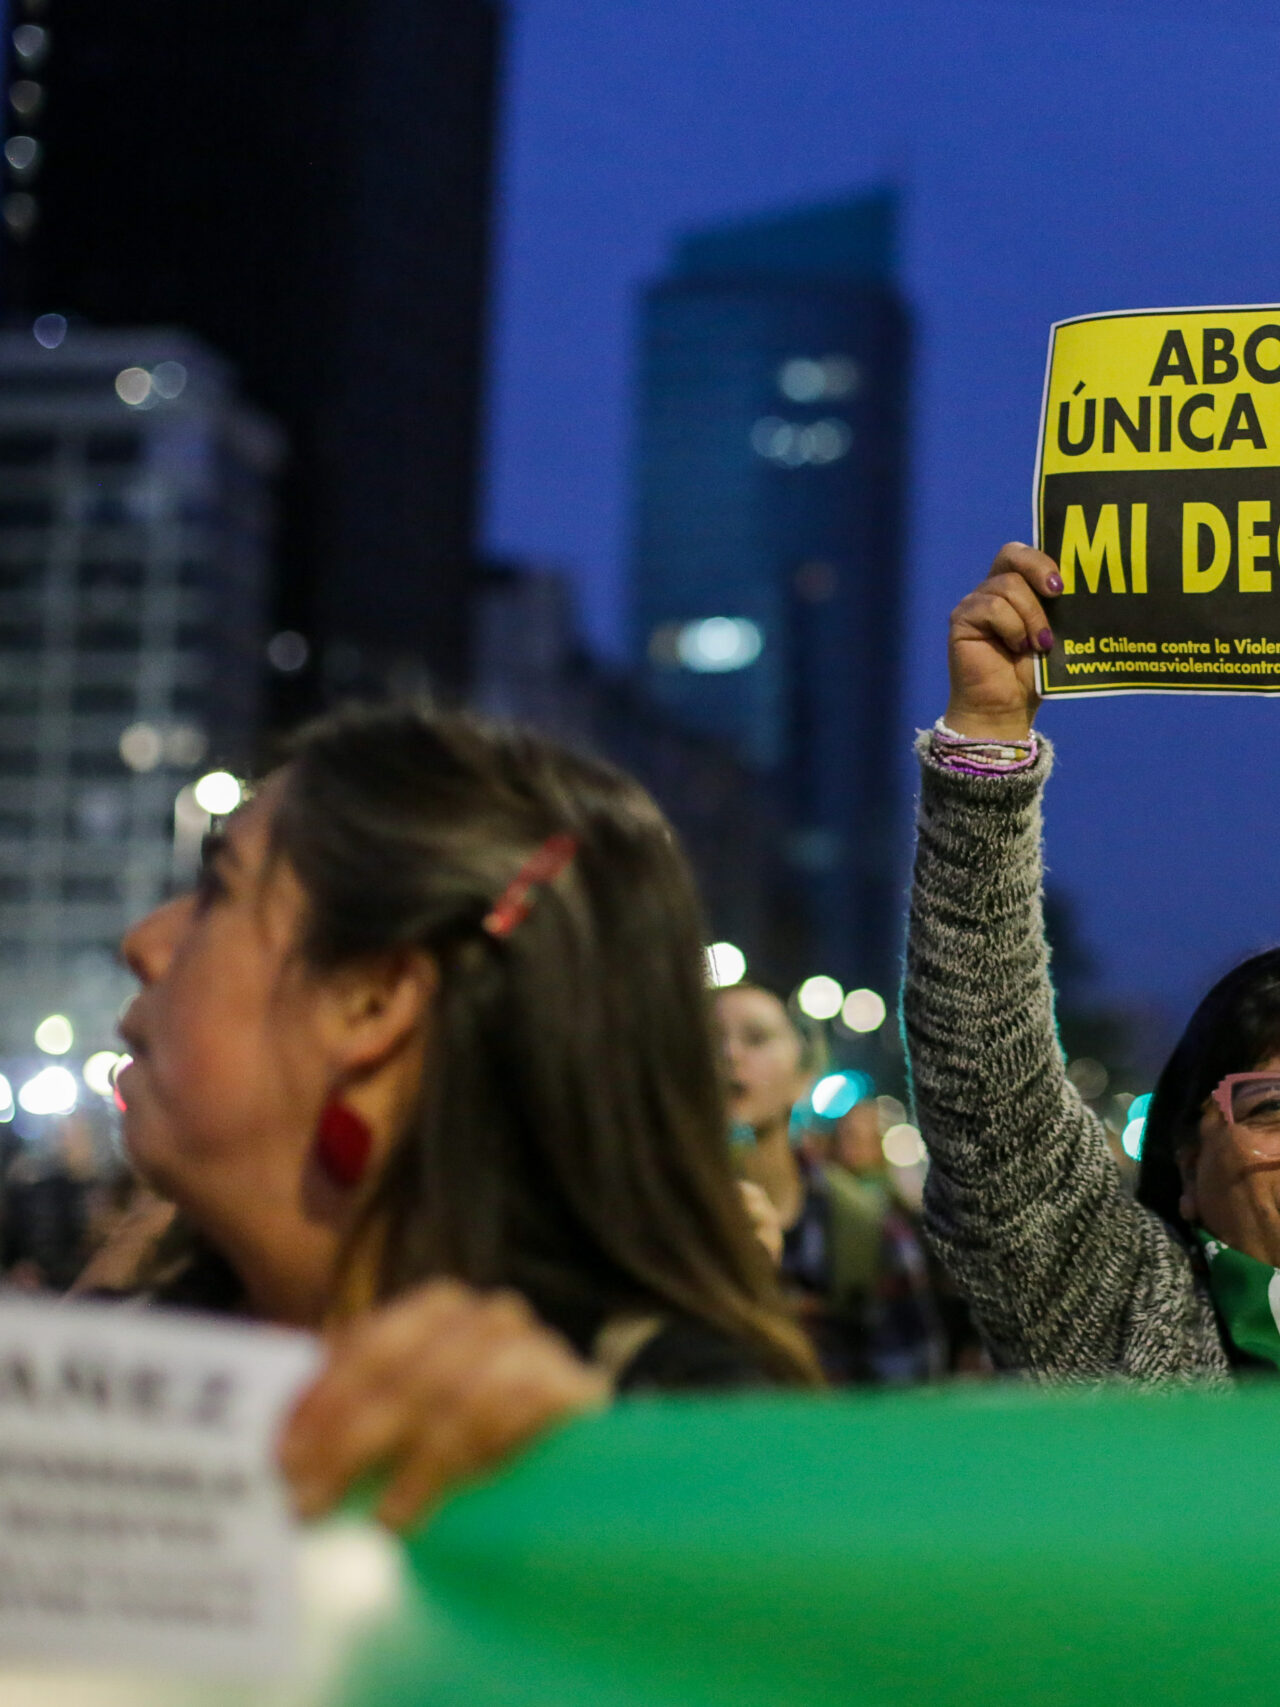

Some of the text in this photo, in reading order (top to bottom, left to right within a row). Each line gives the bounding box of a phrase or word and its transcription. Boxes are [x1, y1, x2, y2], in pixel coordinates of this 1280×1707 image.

[1057, 380, 1267, 456] ÚNICA
[1060, 503, 1147, 595] MI
[1063, 637, 1095, 655] Red
[1099, 637, 1157, 653] Chilena
[1161, 640, 1211, 654] contra
[1215, 638, 1230, 654] la
